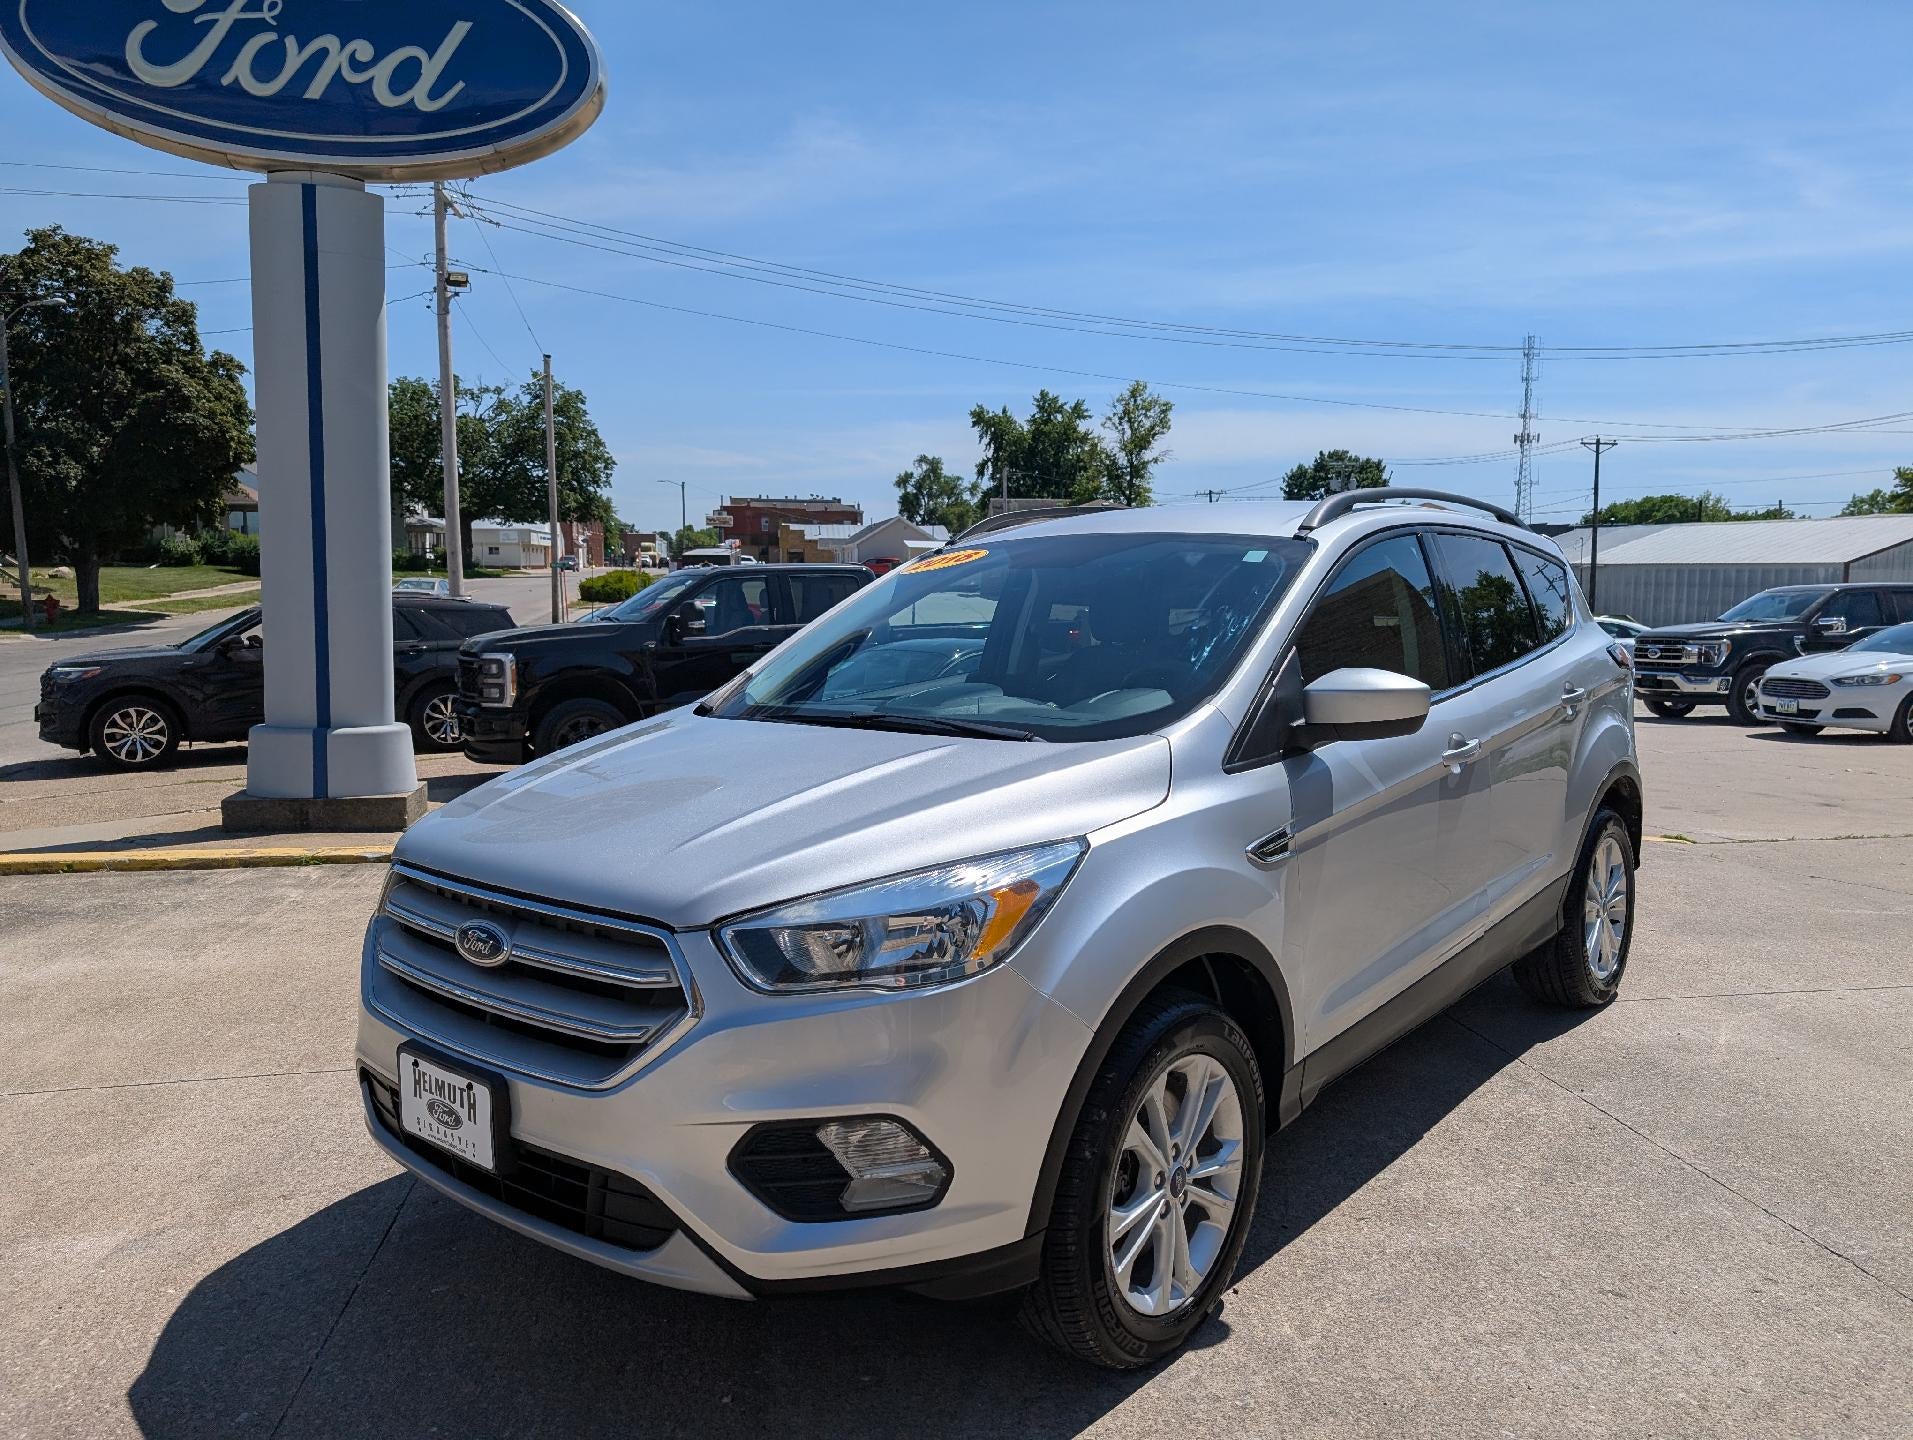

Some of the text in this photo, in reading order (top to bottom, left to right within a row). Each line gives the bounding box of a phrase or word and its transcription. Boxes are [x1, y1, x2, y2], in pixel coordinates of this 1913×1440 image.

[125, 0, 472, 111] Ford
[463, 929, 493, 954] Ford
[412, 1063, 477, 1125] HELMUTH
[431, 1101, 457, 1126] Ford
